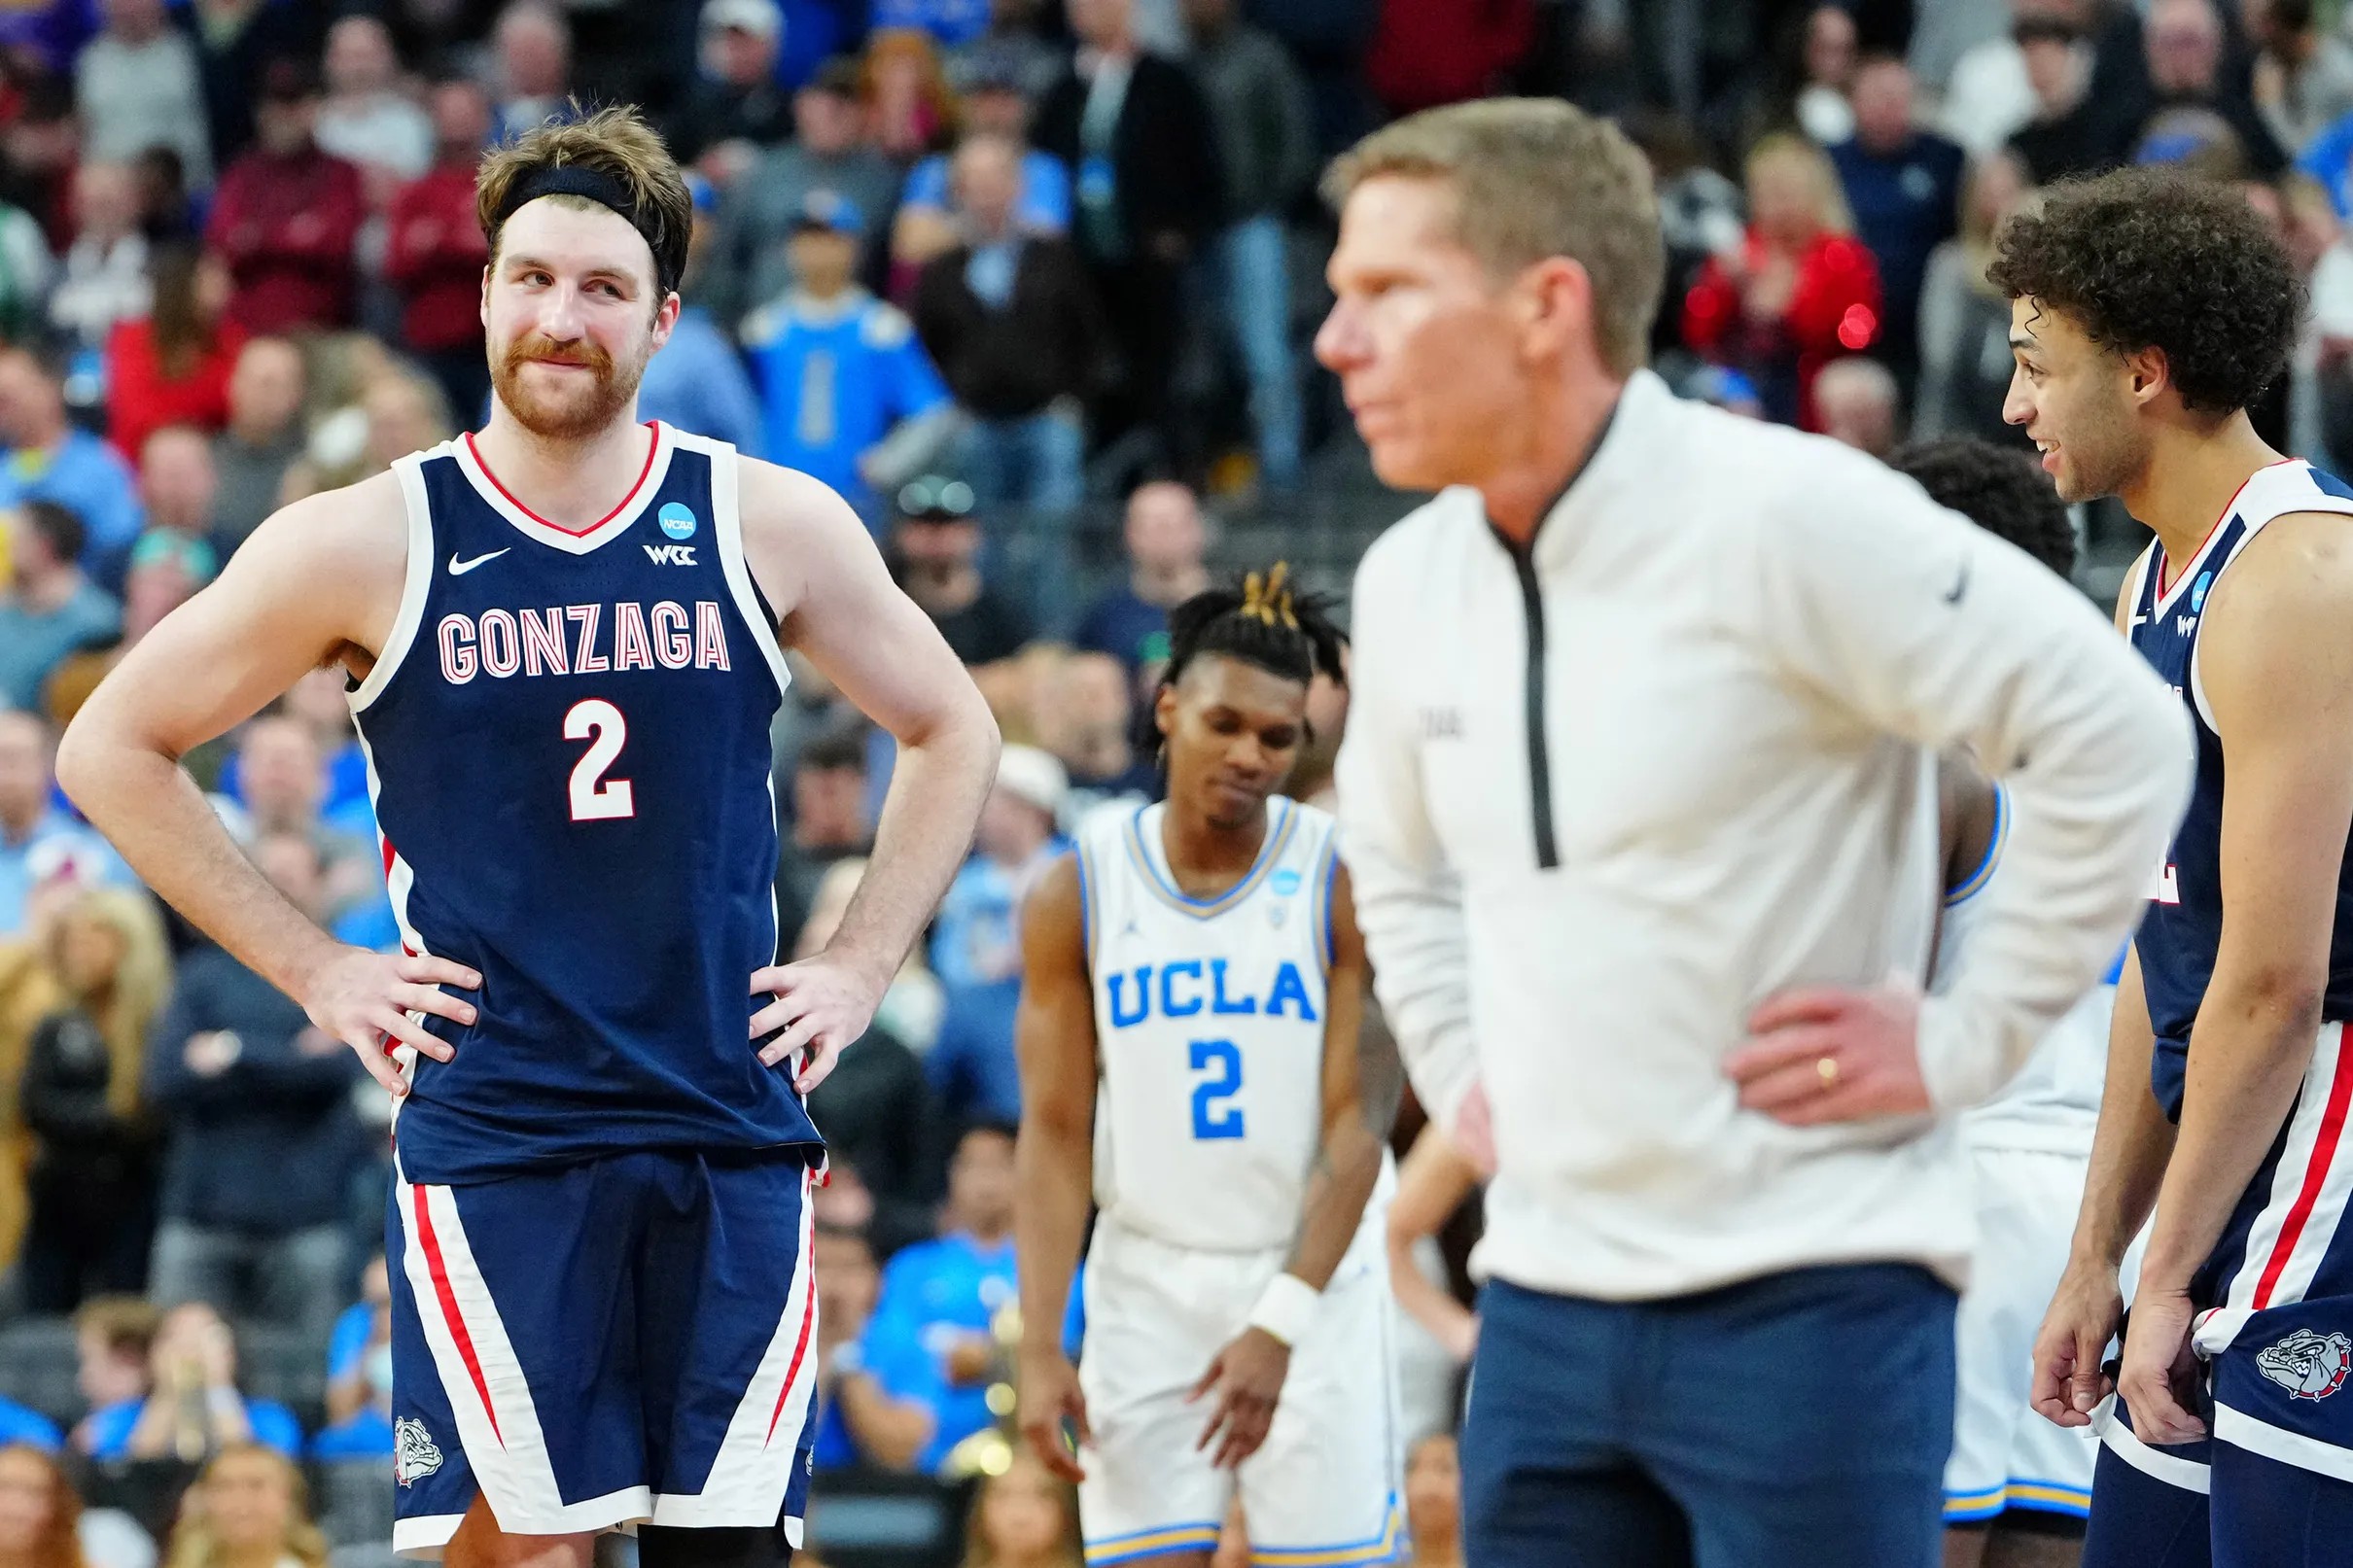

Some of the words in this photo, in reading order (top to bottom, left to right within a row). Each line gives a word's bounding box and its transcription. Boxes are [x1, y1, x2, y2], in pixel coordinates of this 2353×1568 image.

[642, 544, 698, 566] WCC
[663, 518, 694, 531] NCAA
[438, 601, 731, 685] GONZAGA
[562, 697, 636, 821] 2
[1106, 957, 1318, 1028] UCLA
[1188, 1039, 1245, 1140] 2
